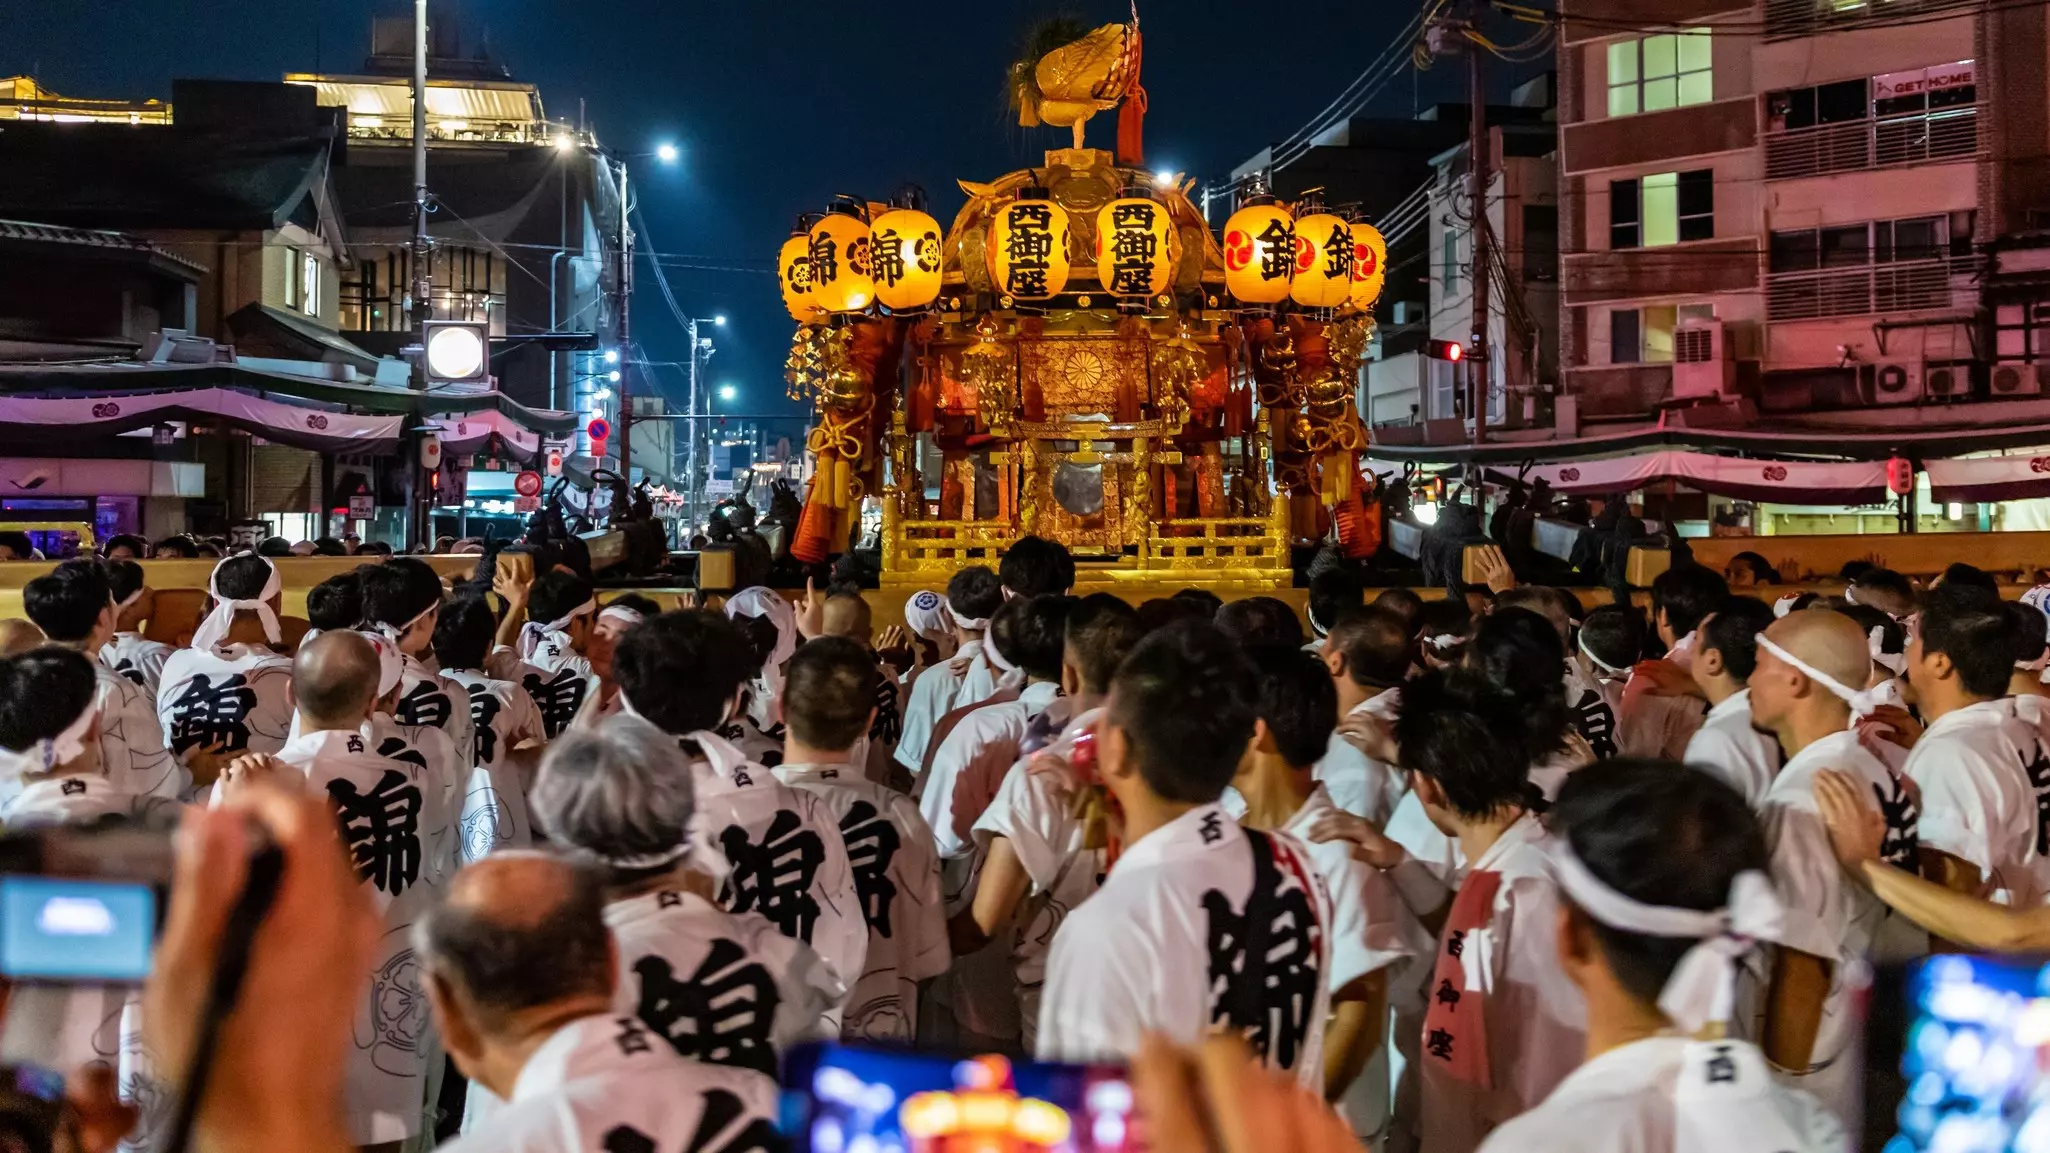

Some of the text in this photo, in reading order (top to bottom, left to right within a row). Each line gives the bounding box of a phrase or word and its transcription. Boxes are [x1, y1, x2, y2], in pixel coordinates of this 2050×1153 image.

[1895, 72, 1972, 93] GET HOME
[808, 231, 838, 287] 錦
[870, 228, 905, 288] 錦
[1005, 204, 1053, 296] 西御座
[1110, 204, 1158, 295] 西御座
[1256, 218, 1296, 285] 錦
[1323, 223, 1354, 284] 錦
[170, 673, 257, 756] 錦
[347, 734, 364, 753] 西
[326, 769, 423, 897] 錦
